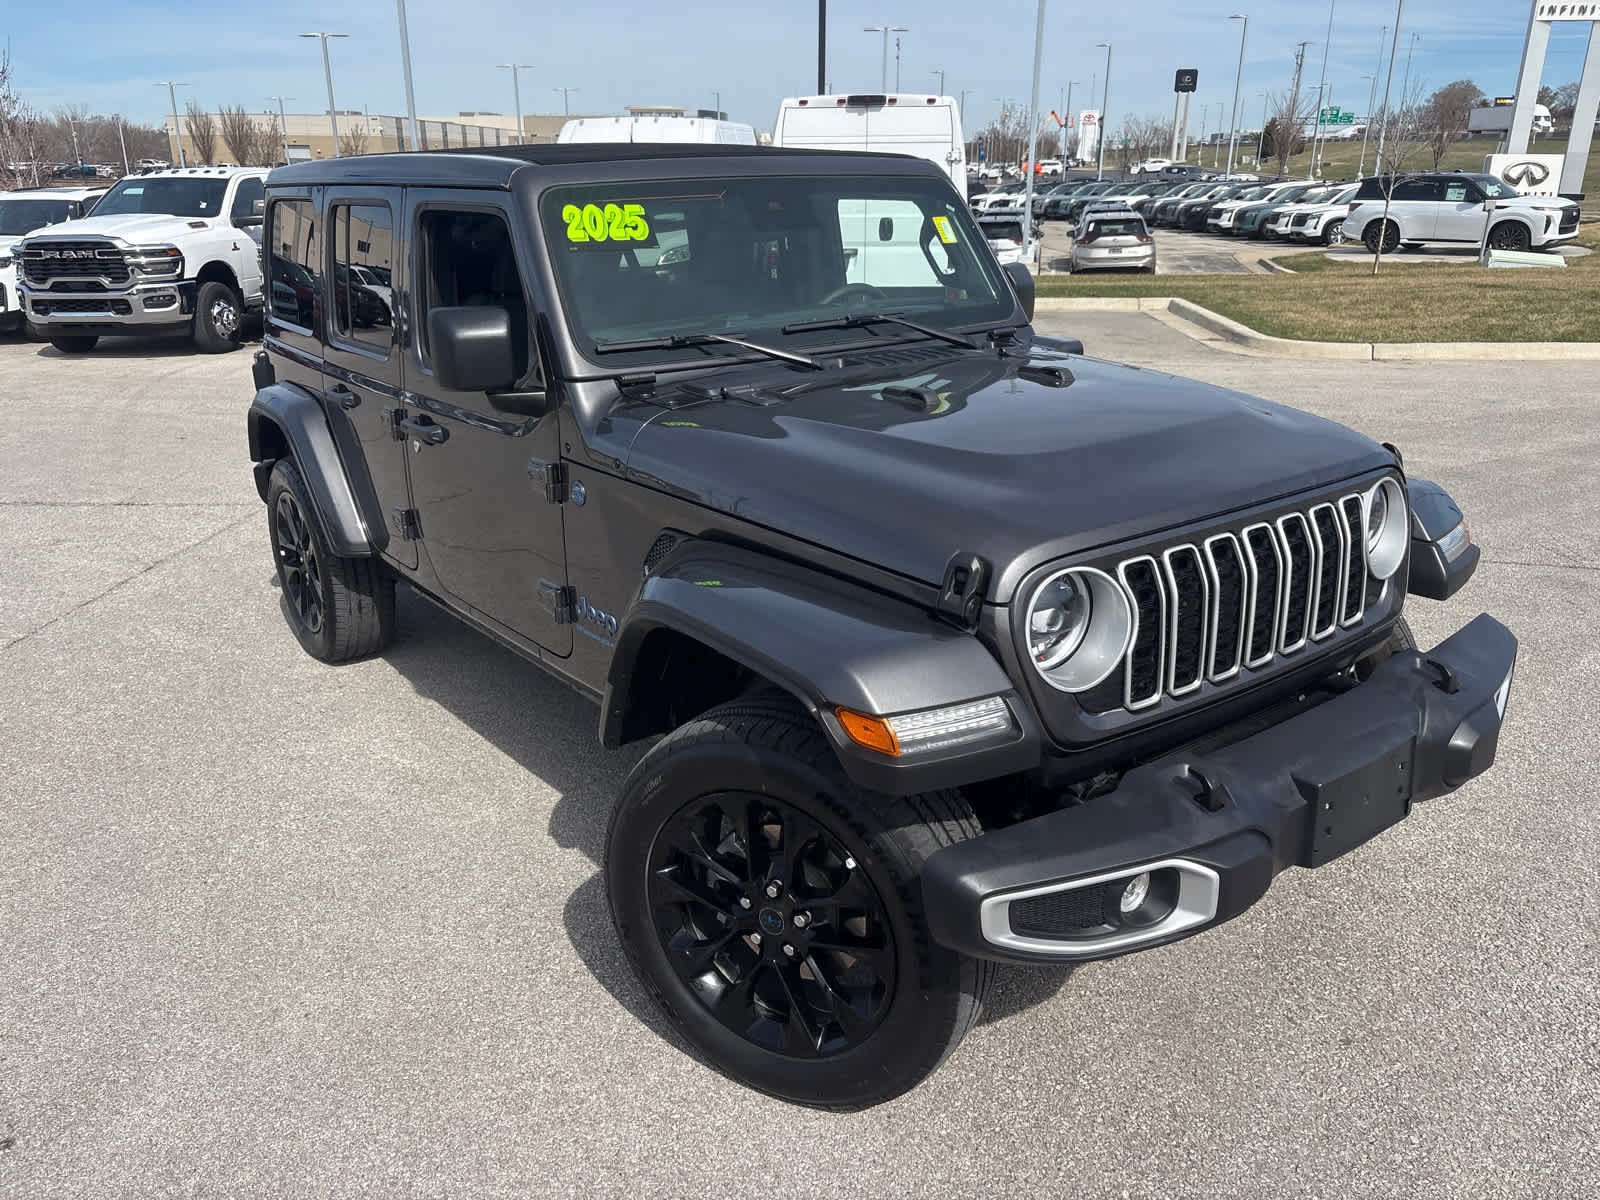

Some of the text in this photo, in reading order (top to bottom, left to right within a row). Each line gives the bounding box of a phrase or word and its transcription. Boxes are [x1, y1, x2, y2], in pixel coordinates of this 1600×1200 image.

[1539, 4, 1600, 16] INFINI
[562, 203, 649, 242] 2025
[42, 249, 96, 259] RAM
[575, 595, 618, 637] Jeep
